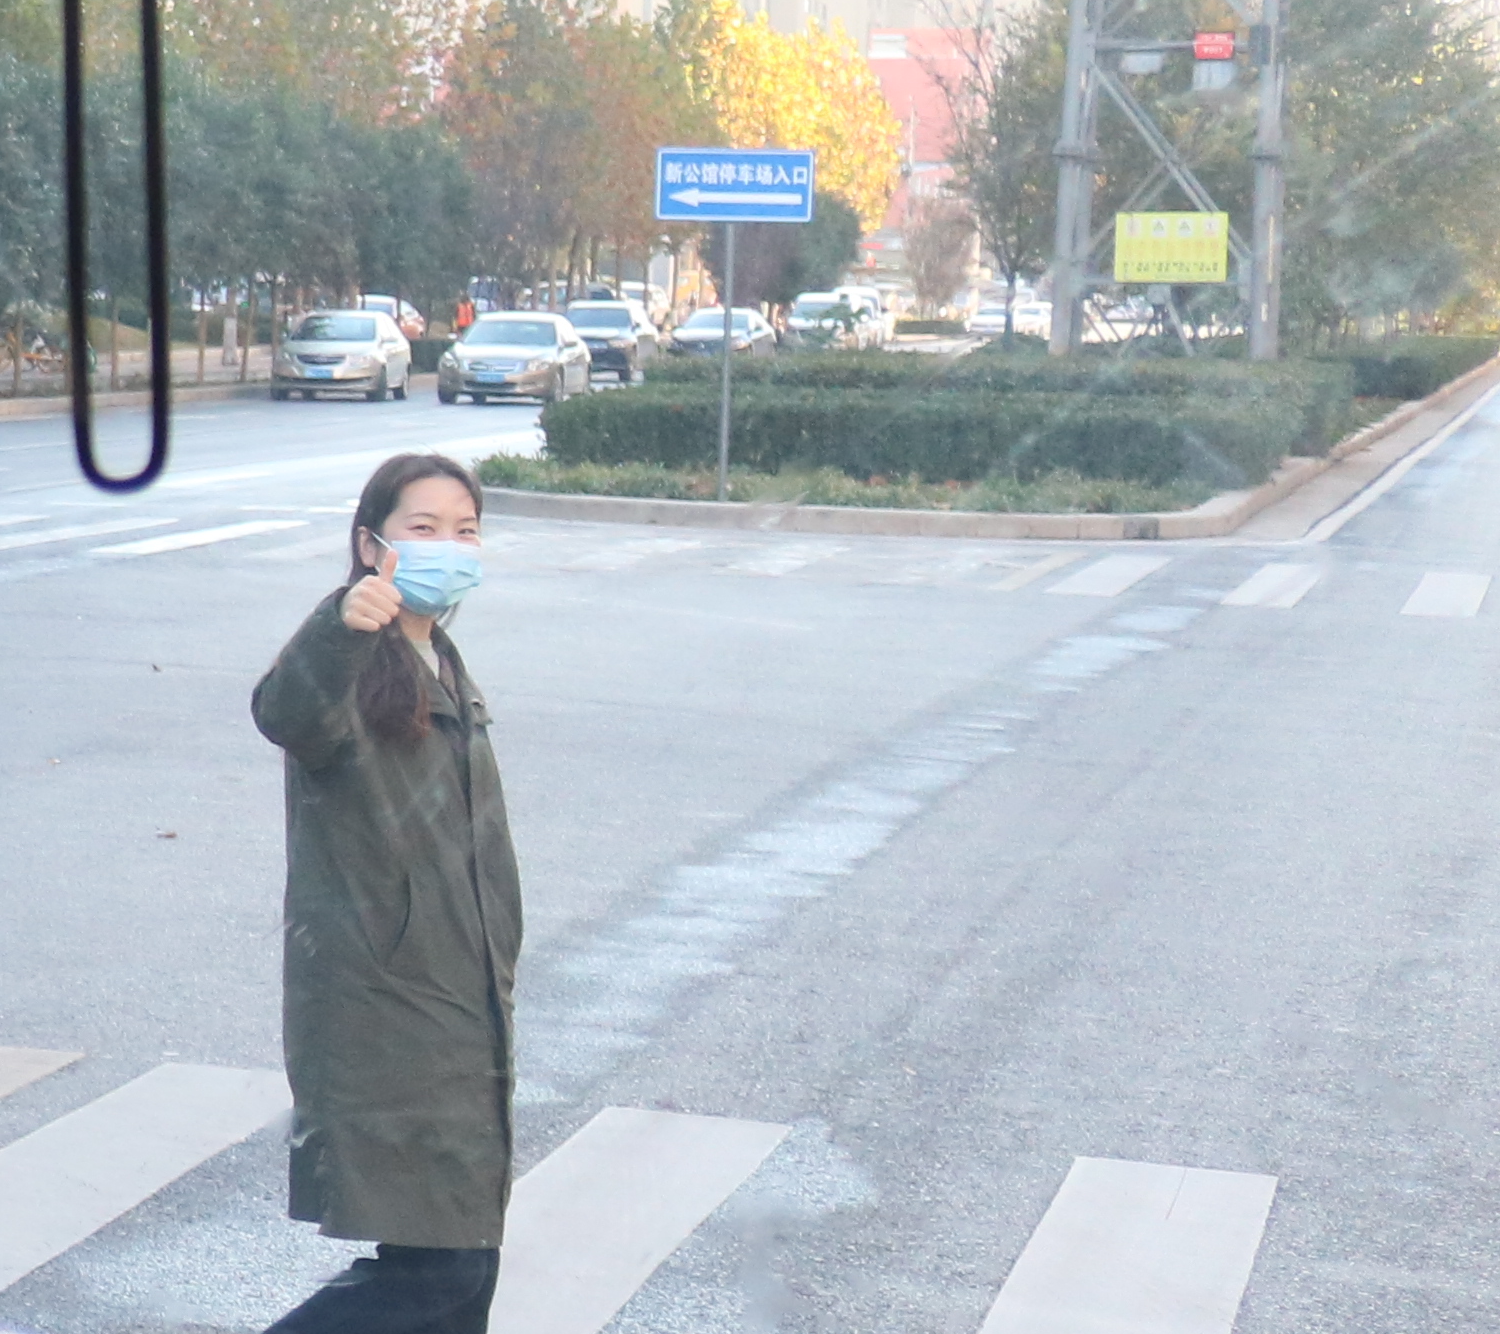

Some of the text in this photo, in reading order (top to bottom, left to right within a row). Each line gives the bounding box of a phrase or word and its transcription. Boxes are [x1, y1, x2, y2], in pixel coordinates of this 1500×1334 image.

[664, 161, 809, 186] 新公馆停车场入口
